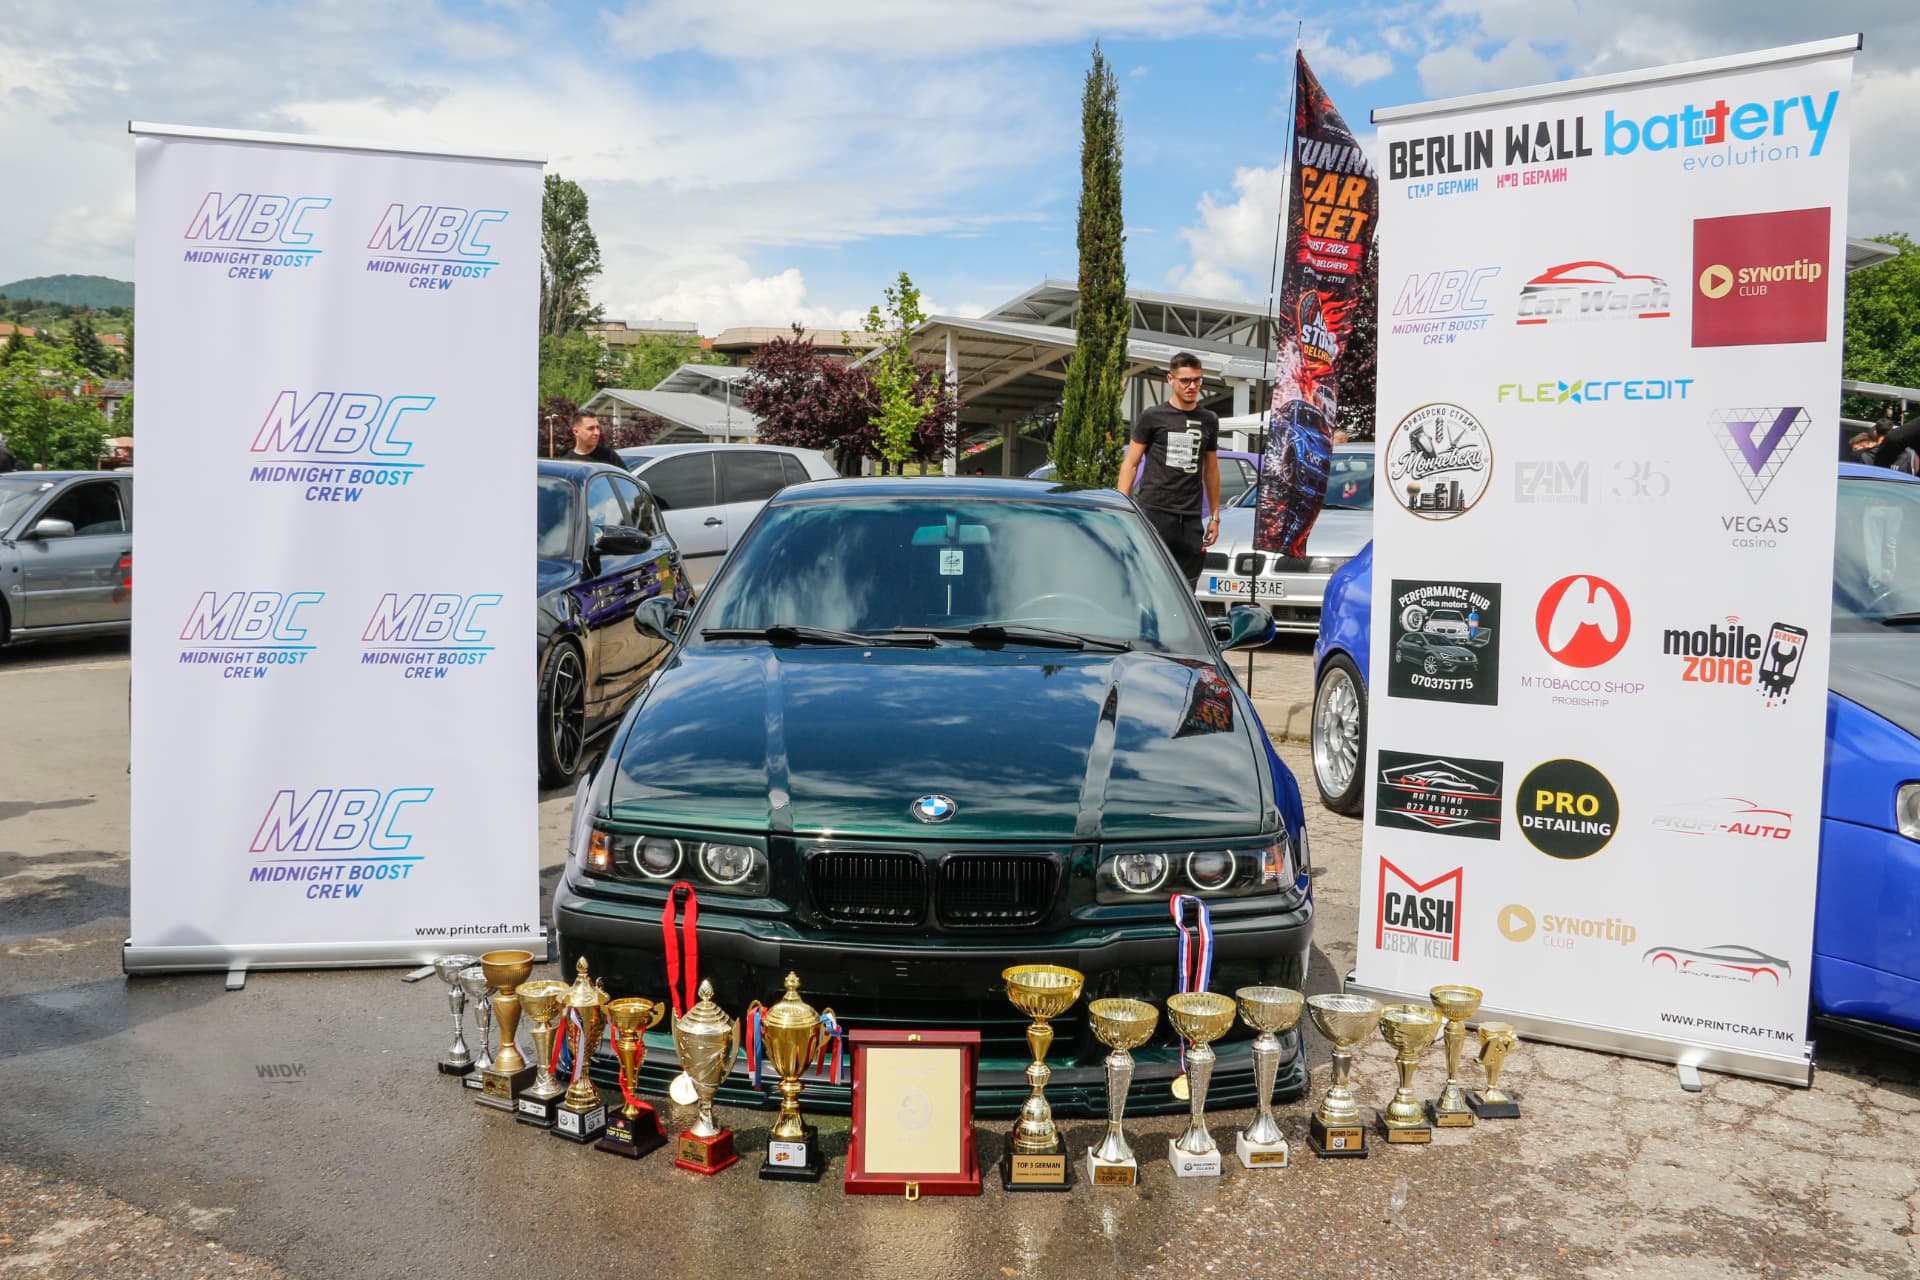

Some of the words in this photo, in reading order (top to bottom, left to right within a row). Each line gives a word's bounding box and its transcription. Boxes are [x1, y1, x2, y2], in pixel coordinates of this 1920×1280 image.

[1604, 90, 1840, 157] battery
[1389, 128, 1493, 180] BERLIN
[1505, 116, 1592, 166] WALL
[1683, 142, 1799, 172] evolution
[1302, 167, 1367, 208] CAR
[1408, 184, 1433, 199] СТАР
[184, 192, 332, 244] MBC
[1304, 201, 1368, 242] EET
[367, 203, 508, 256] MBC
[1326, 243, 1349, 255] 2026
[184, 251, 260, 265] MIDNIGHT
[262, 254, 312, 268] BOOST
[227, 267, 273, 280] CREW
[366, 260, 439, 275] MIDNIGHT
[441, 265, 491, 279] BOOST
[409, 277, 453, 290] CREW
[1392, 267, 1501, 316] MBC
[1738, 285, 1767, 296] CLUB
[1518, 295, 1571, 316] Car
[1580, 287, 1670, 312] Wash
[1392, 322, 1445, 335] MIDNIGHT
[1448, 319, 1487, 333] BOOST
[1423, 333, 1456, 345] CREW
[250, 391, 436, 456] MBC
[1403, 408, 1446, 431] ФРИЗЕРСКО
[1450, 410, 1477, 432] СТУДИО
[1392, 448, 1484, 480] Мончевски
[250, 467, 346, 483] MIDNIGHT
[349, 470, 413, 486] BOOST
[305, 486, 363, 502] CREW
[1721, 516, 1788, 533] VEGAS
[1732, 537, 1777, 549] casino
[1218, 580, 1231, 592] KO
[1398, 586, 1469, 607] PERFORMANCE
[1469, 592, 1490, 610] HUB
[1421, 599, 1440, 607] Coka
[1441, 600, 1468, 608] motors
[179, 592, 326, 641] MBC
[361, 593, 503, 642] MBC
[1664, 624, 1761, 660] mobile
[179, 651, 255, 664] MIDNIGHT
[257, 652, 307, 665] BOOST
[361, 652, 436, 665] MIDNIGHT
[437, 652, 487, 665] BOOST
[223, 666, 268, 679] CREW
[404, 666, 448, 679] CREW
[1683, 657, 1752, 685] zone
[1411, 674, 1473, 690] 070375775
[1521, 676, 1531, 687] M
[1535, 677, 1600, 692] TOBACCO
[1604, 681, 1644, 693] SHOP
[1552, 697, 1609, 707] PROBISHTIP
[1413, 793, 1436, 802] AUTO
[1536, 790, 1599, 817] PRO
[1407, 803, 1423, 811] 077
[249, 787, 434, 853] MBC
[1522, 815, 1611, 837] DETAILING
[249, 865, 346, 882] MIDNIGHT
[349, 864, 413, 880] BOOST
[306, 883, 363, 899] CREW
[1385, 892, 1453, 933] CASH
[415, 923, 531, 936] www.printcraft.mk
[1383, 932, 1417, 955] СВЕЖ
[1424, 938, 1451, 960] КЕШ
[1543, 936, 1575, 949] CLUB
[1661, 1013, 1794, 1041] WWW.PRINTCRAFT.MK
